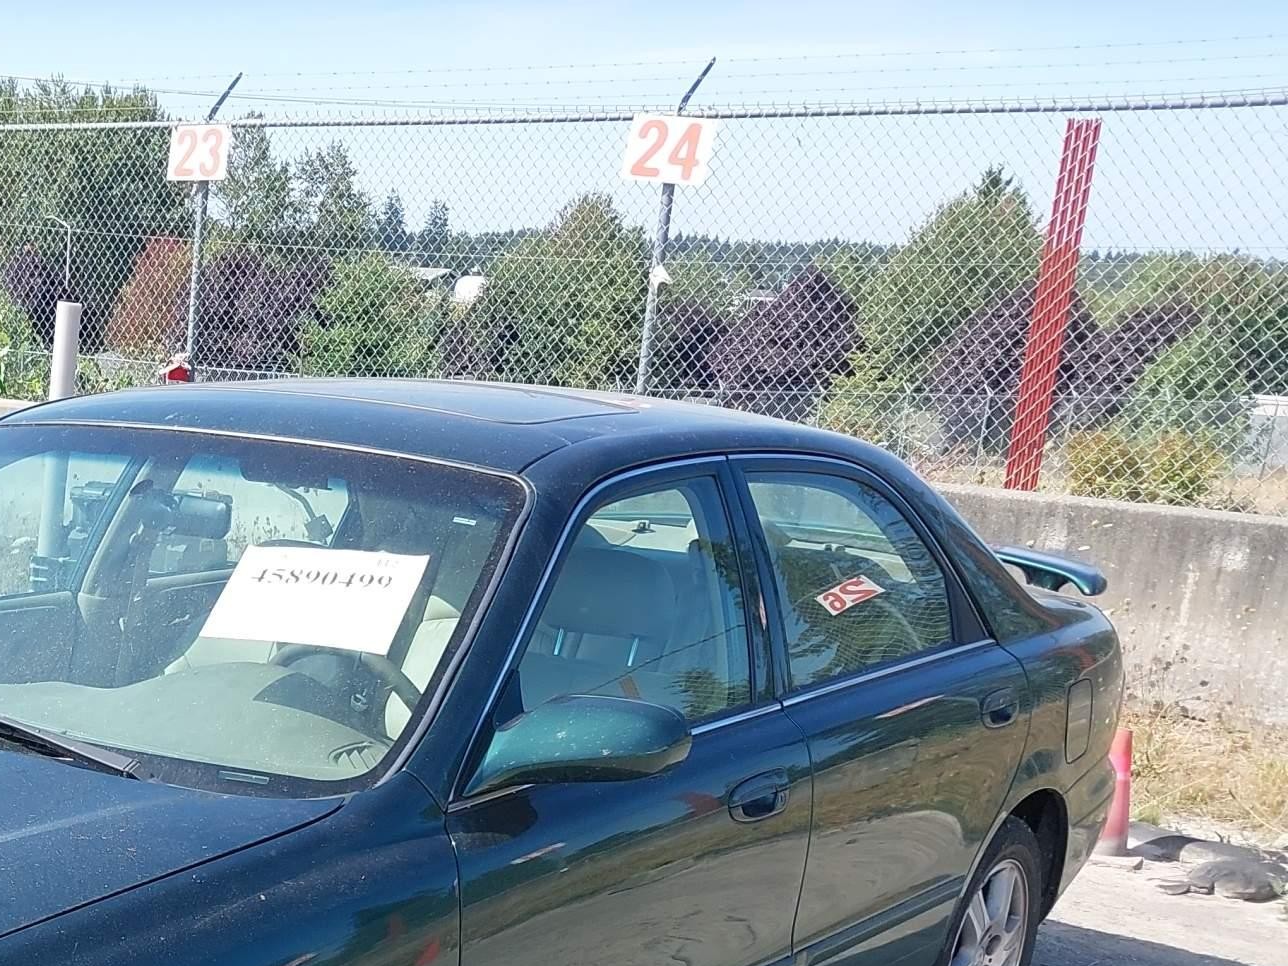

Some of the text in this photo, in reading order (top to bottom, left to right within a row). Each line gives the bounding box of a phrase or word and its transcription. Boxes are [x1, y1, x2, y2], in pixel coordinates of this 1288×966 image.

[175, 129, 222, 177] 23
[630, 118, 705, 181] 24
[251, 567, 394, 589] 45890499
